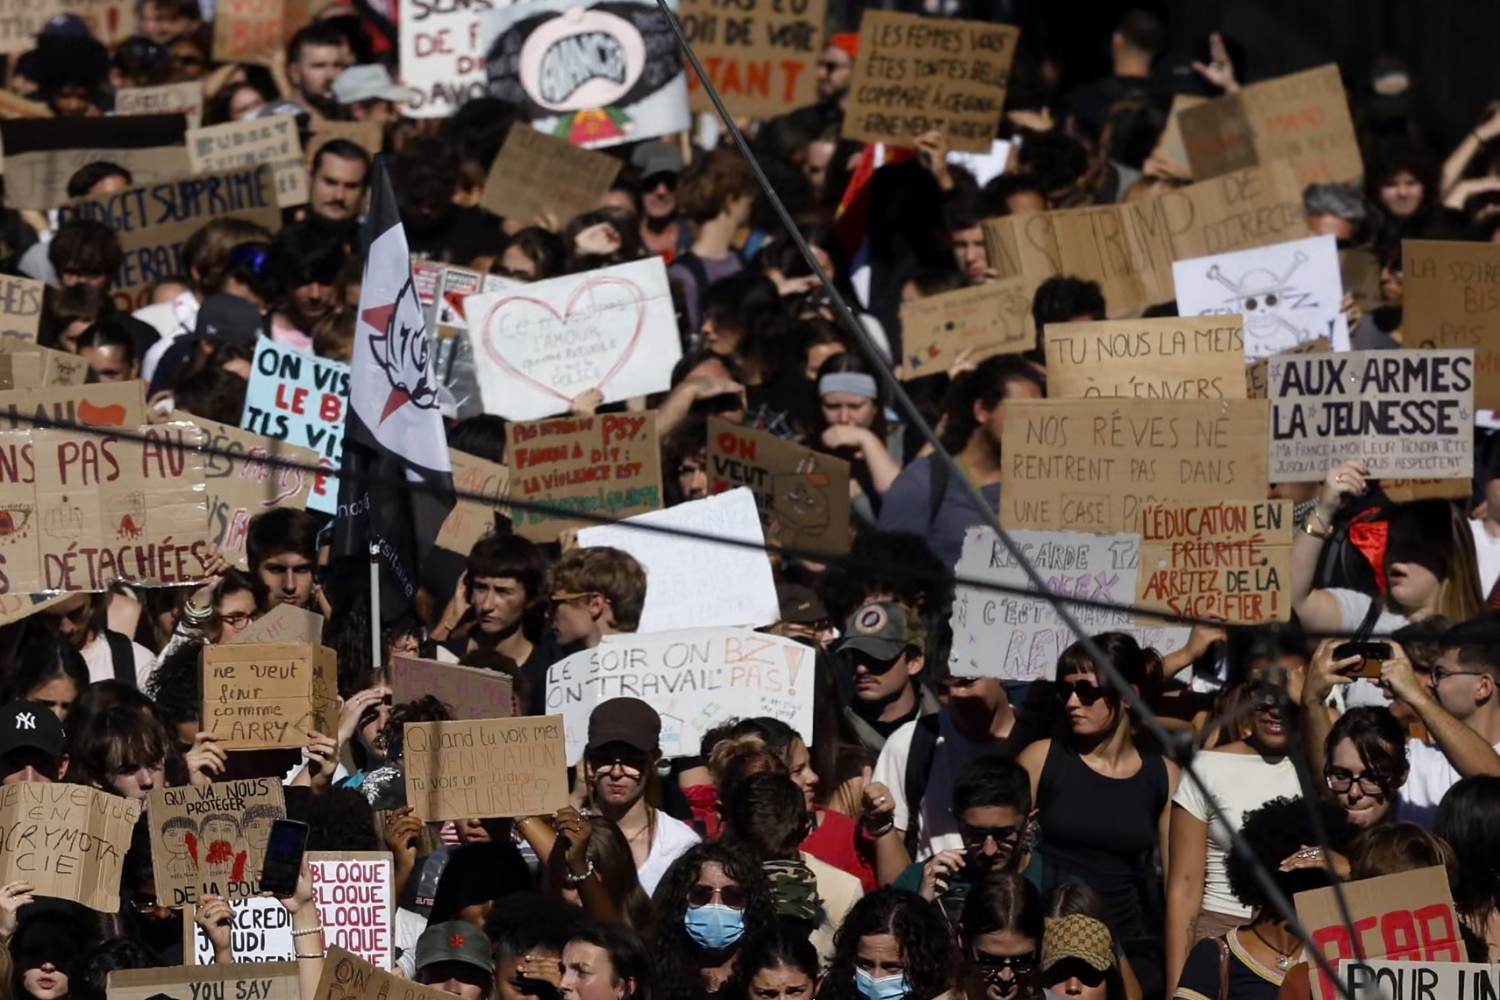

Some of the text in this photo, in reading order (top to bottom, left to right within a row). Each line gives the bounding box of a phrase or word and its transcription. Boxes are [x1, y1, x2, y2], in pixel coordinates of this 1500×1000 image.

[1050, 327, 1243, 364] TU NOUS LA METS
[1279, 357, 1472, 397] AUX ARMES
[1026, 410, 1230, 450] NOS RÊVES NE
[1273, 400, 1460, 440] LA JEUNESSE
[57, 436, 123, 486] PAS
[141, 428, 186, 479] AU
[716, 431, 757, 462] ON
[1013, 454, 1236, 485] RENTRENT PAS DANS
[1014, 499, 1106, 524] UNE CASE
[1253, 504, 1283, 530] EN
[43, 535, 207, 592] DÉTACHÉES
[1226, 567, 1281, 593] DE LA
[250, 665, 299, 680] veut
[545, 638, 712, 686] LE SOIR ON
[545, 681, 587, 711] ON
[728, 665, 784, 693] PAS
[406, 724, 559, 752] Quand tu vois mes
[164, 778, 270, 807] QUI NOUS
[463, 775, 477, 786] un
[28, 805, 71, 824] EN
[15, 852, 80, 875] CIE
[174, 888, 196, 905] DE
[236, 980, 273, 1000] SAY
